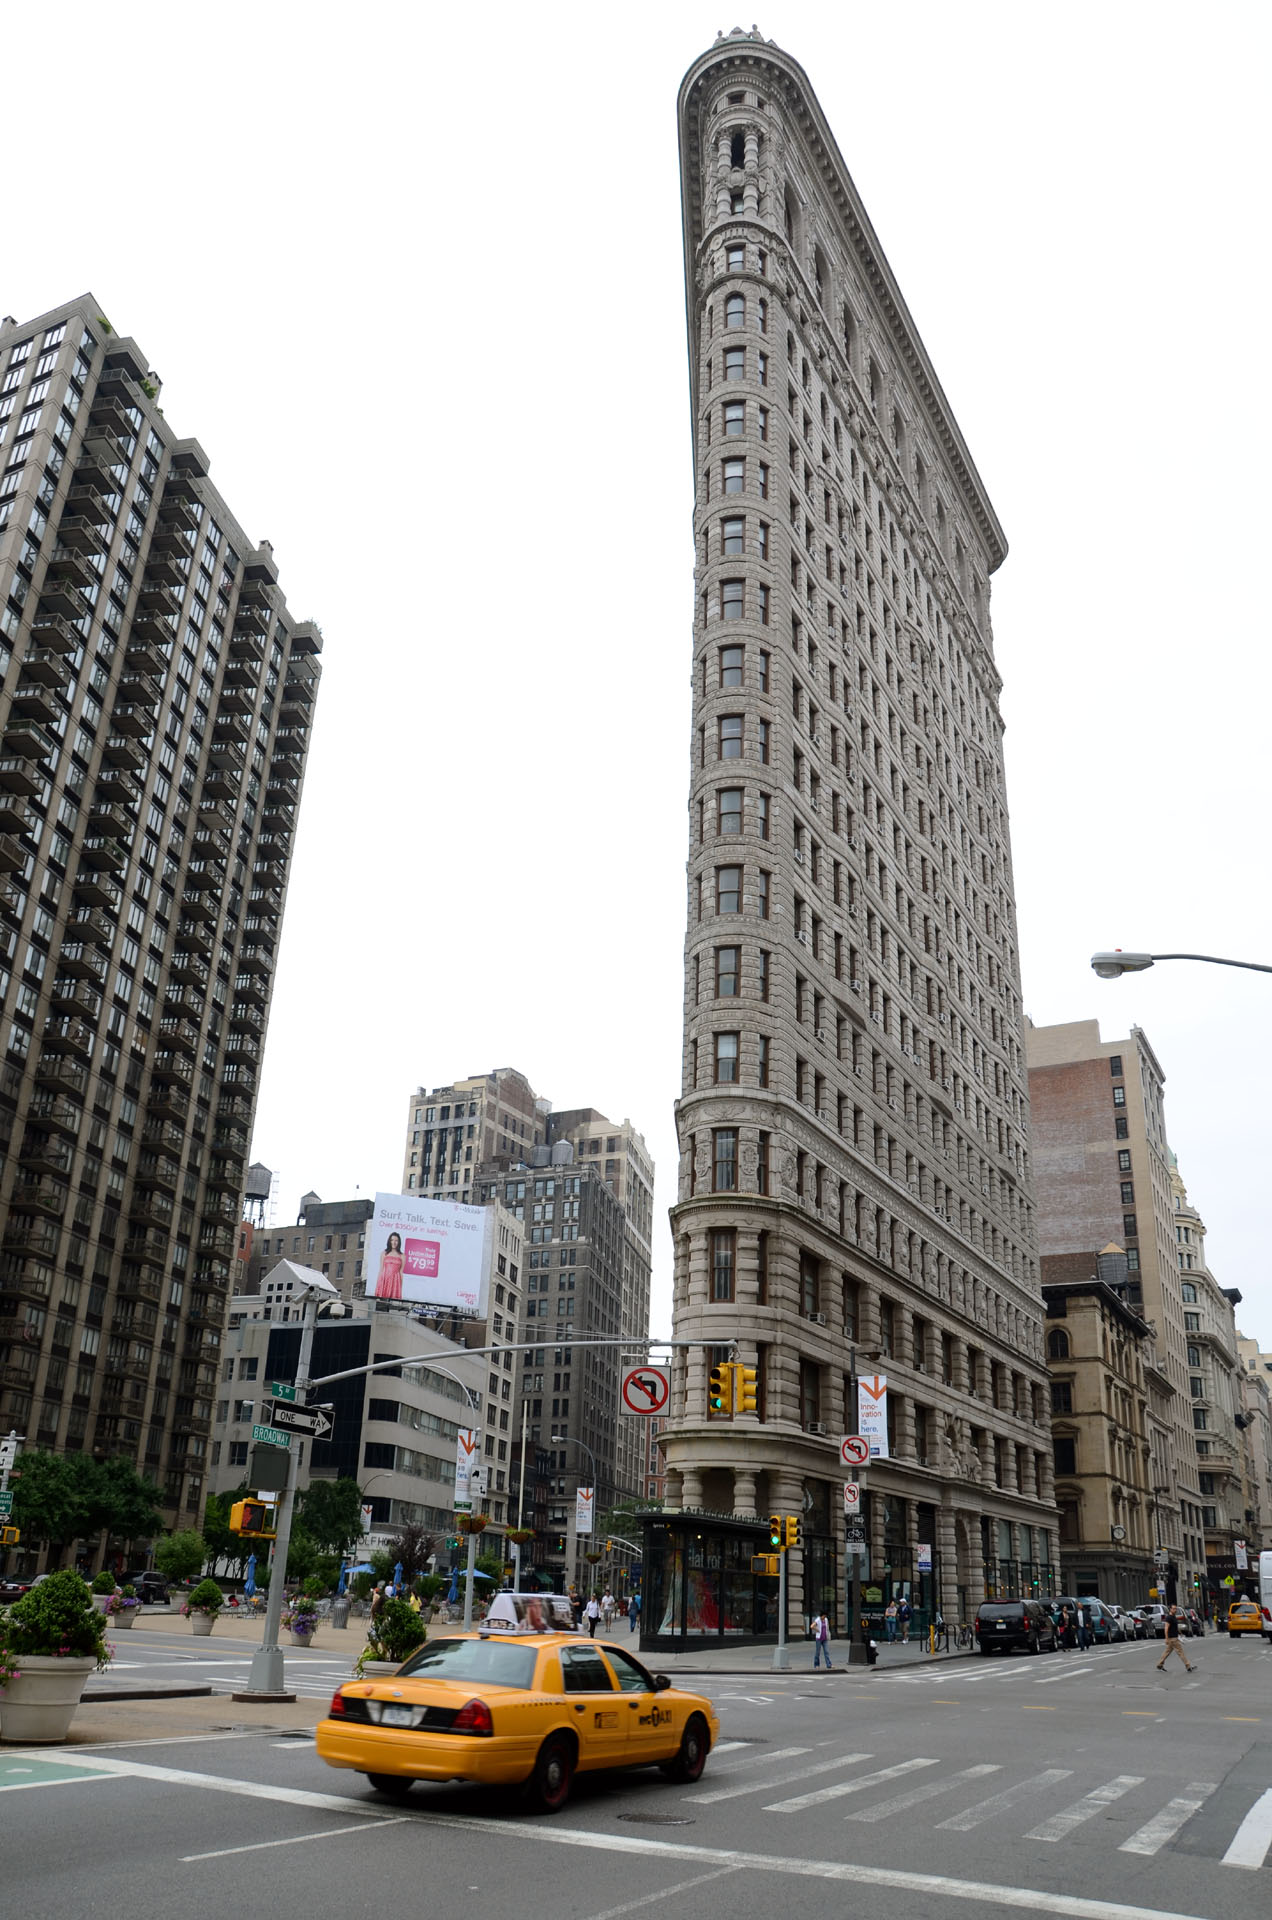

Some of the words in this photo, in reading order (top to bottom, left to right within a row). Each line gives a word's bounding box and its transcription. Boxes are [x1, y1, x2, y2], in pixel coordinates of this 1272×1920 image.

[380, 1209, 403, 1220] Surf.
[406, 1213, 427, 1224] Talk.
[430, 1216, 451, 1228] Text.
[454, 1220, 479, 1231] Save.
[278, 1386, 284, 1397] 5
[280, 1411, 296, 1423] ONE
[309, 1417, 327, 1430] WAY
[253, 1427, 289, 1446] BROADWAY
